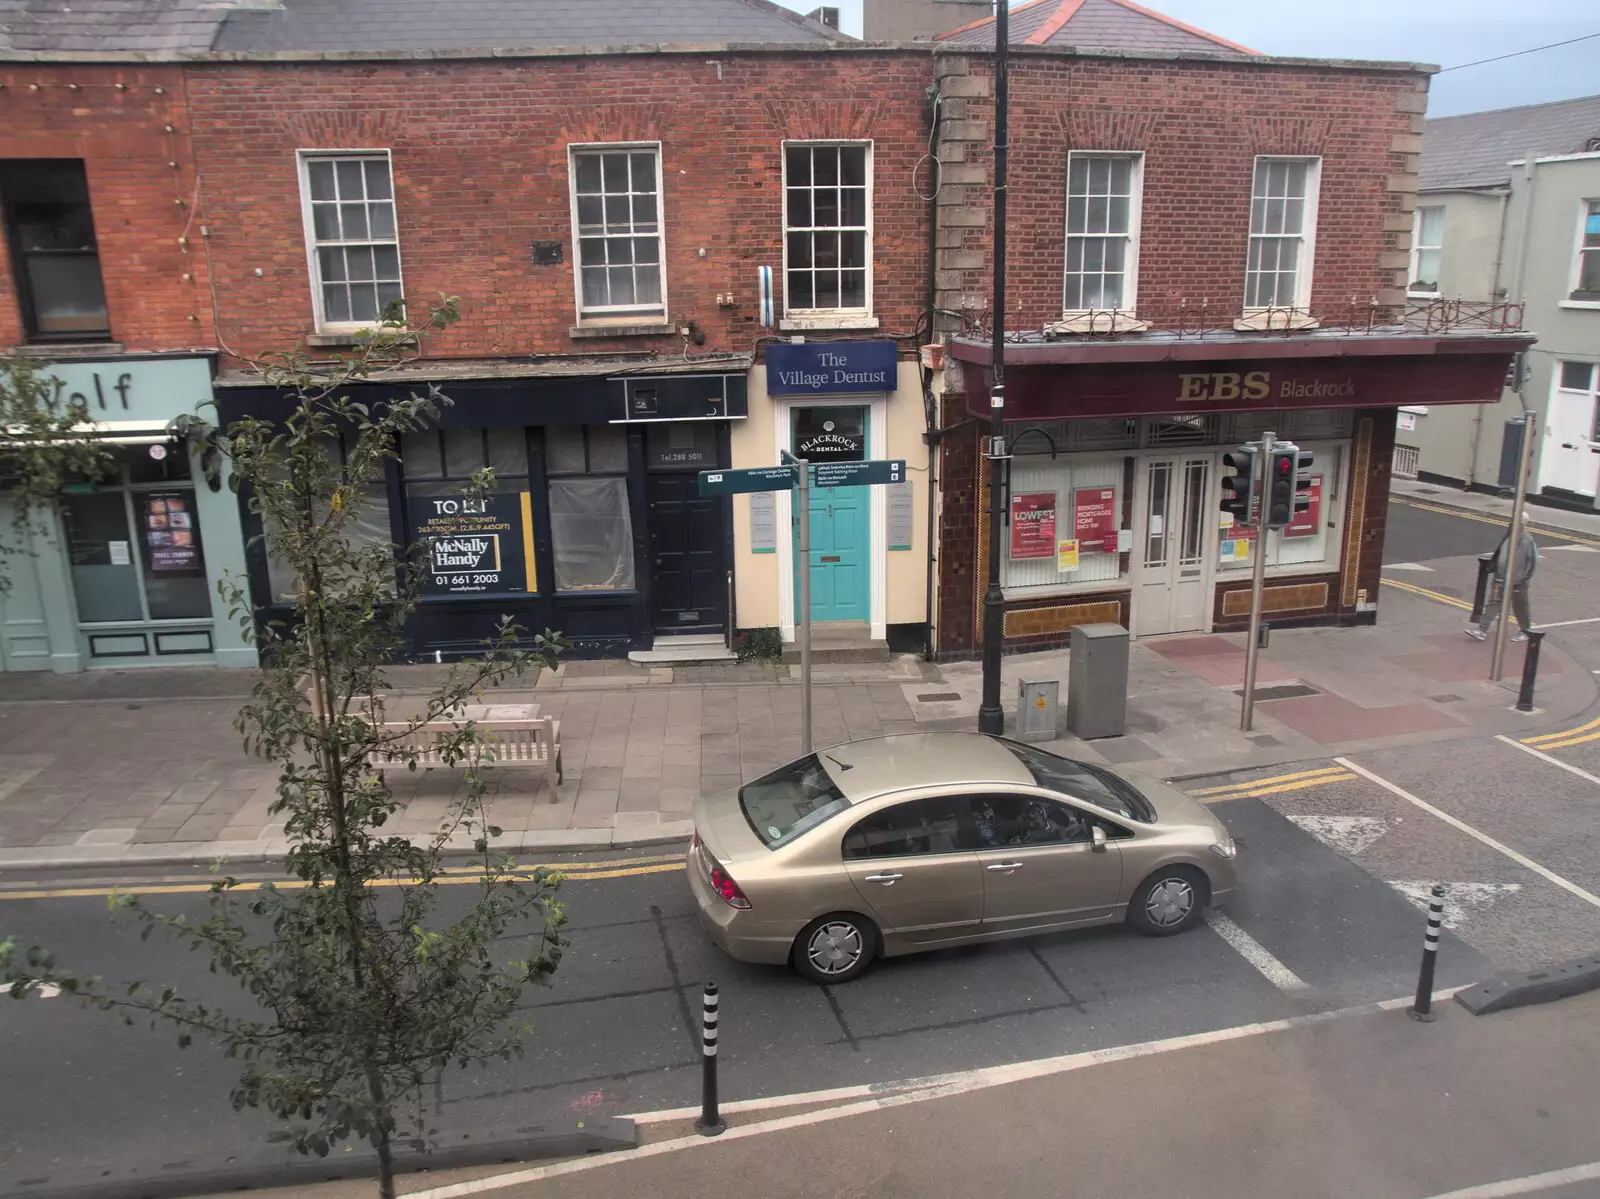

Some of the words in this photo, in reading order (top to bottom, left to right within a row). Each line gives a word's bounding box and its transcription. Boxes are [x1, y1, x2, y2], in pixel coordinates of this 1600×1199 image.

[818, 353, 847, 366] The
[779, 370, 829, 388] Village
[834, 370, 886, 383] Dentist
[1176, 371, 1270, 401] EBS
[1280, 378, 1356, 398] Blackrock
[801, 435, 857, 451] BLACKROCK
[661, 453, 686, 461] Tel.288
[688, 452, 703, 460] 5011
[433, 500, 458, 514] TO
[463, 499, 488, 513] LT
[1077, 510, 1111, 518] MORTGAGES
[435, 539, 489, 554] McNally
[436, 552, 480, 567] Handy
[436, 576, 448, 585] 01
[451, 575, 470, 584] 661
[473, 574, 499, 583] 2003
